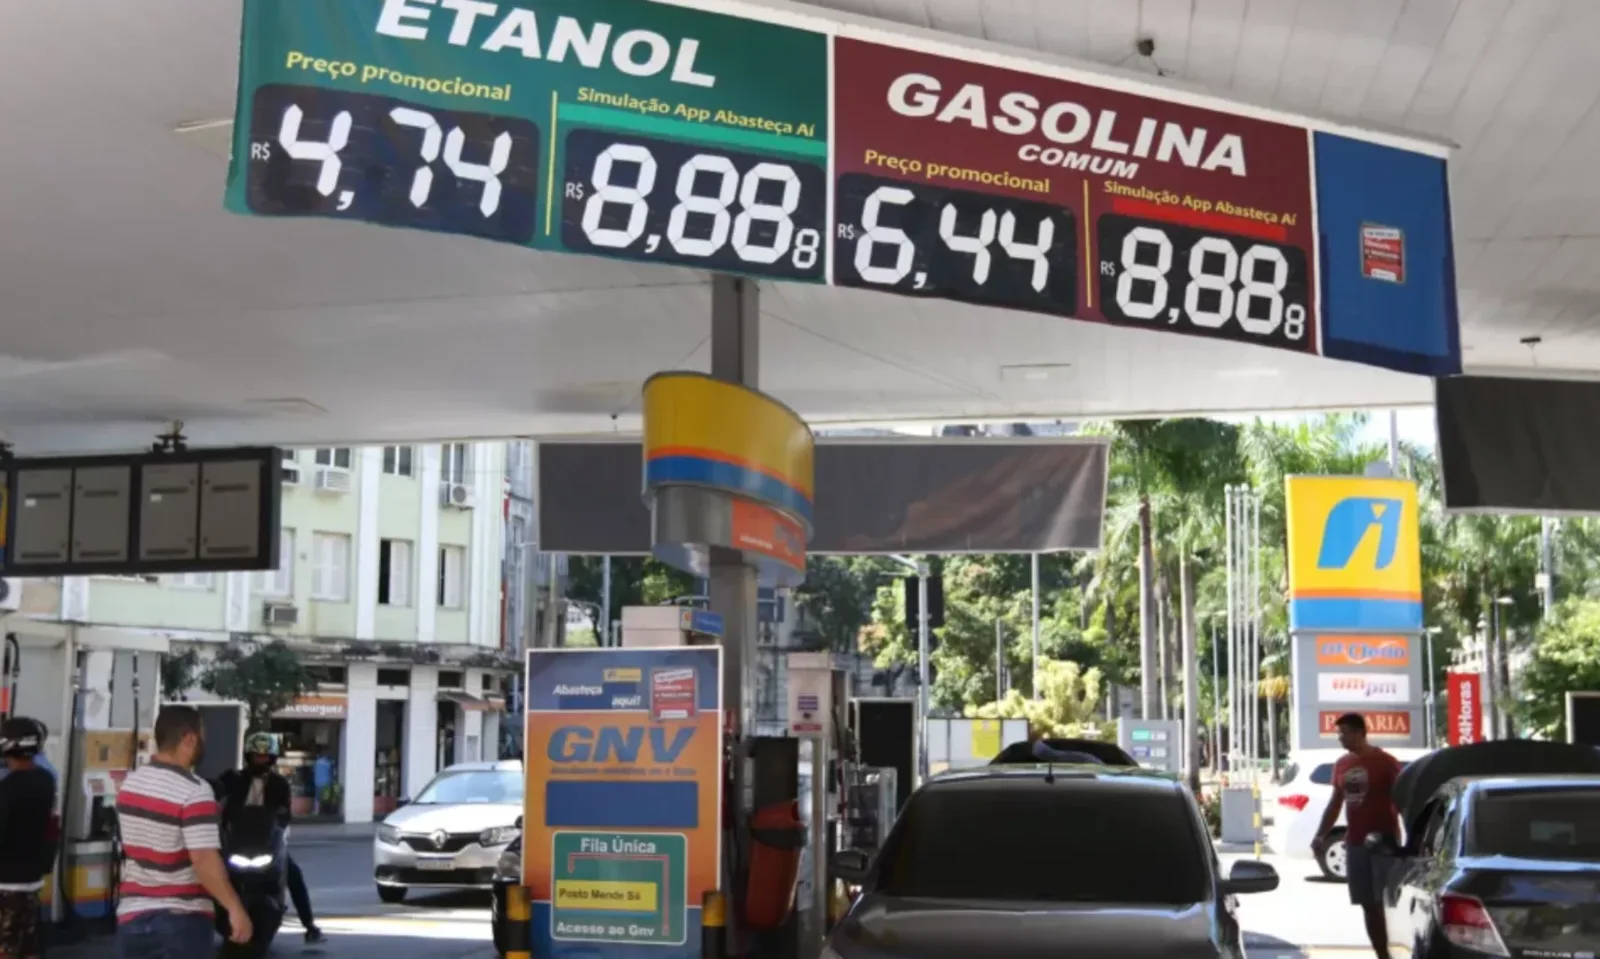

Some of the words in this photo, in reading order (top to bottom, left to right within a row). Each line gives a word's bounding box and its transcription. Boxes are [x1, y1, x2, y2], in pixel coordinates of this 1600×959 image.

[375, 0, 716, 88] ETANOL
[286, 51, 357, 80] Preço
[361, 64, 512, 101] promocional
[577, 87, 670, 115] Simulação
[674, 104, 711, 122] App
[714, 110, 792, 135] Abasteça
[796, 121, 816, 137] Aí
[887, 73, 1247, 177] GASOLINA
[251, 142, 270, 160] R$
[278, 104, 513, 218] 4,74
[864, 149, 922, 175] Preço
[926, 162, 1050, 193] promocional
[1018, 144, 1139, 180] COMUM
[565, 183, 584, 201] R$
[1104, 180, 1179, 205] Simulação
[1182, 195, 1211, 214] App
[1215, 201, 1278, 224] Abasteça
[1281, 213, 1297, 226] Aí
[837, 224, 854, 240] R$
[854, 186, 1055, 293] 6,44
[1101, 261, 1116, 277] R$
[1325, 714, 1406, 732] PARIA
[547, 725, 697, 763] GNV
[581, 838, 608, 852] Fila
[612, 836, 656, 854] Única
[559, 888, 588, 899] Posto
[556, 922, 605, 934] Acesso
[608, 926, 625, 936] ao
[628, 925, 655, 937] Gnv
